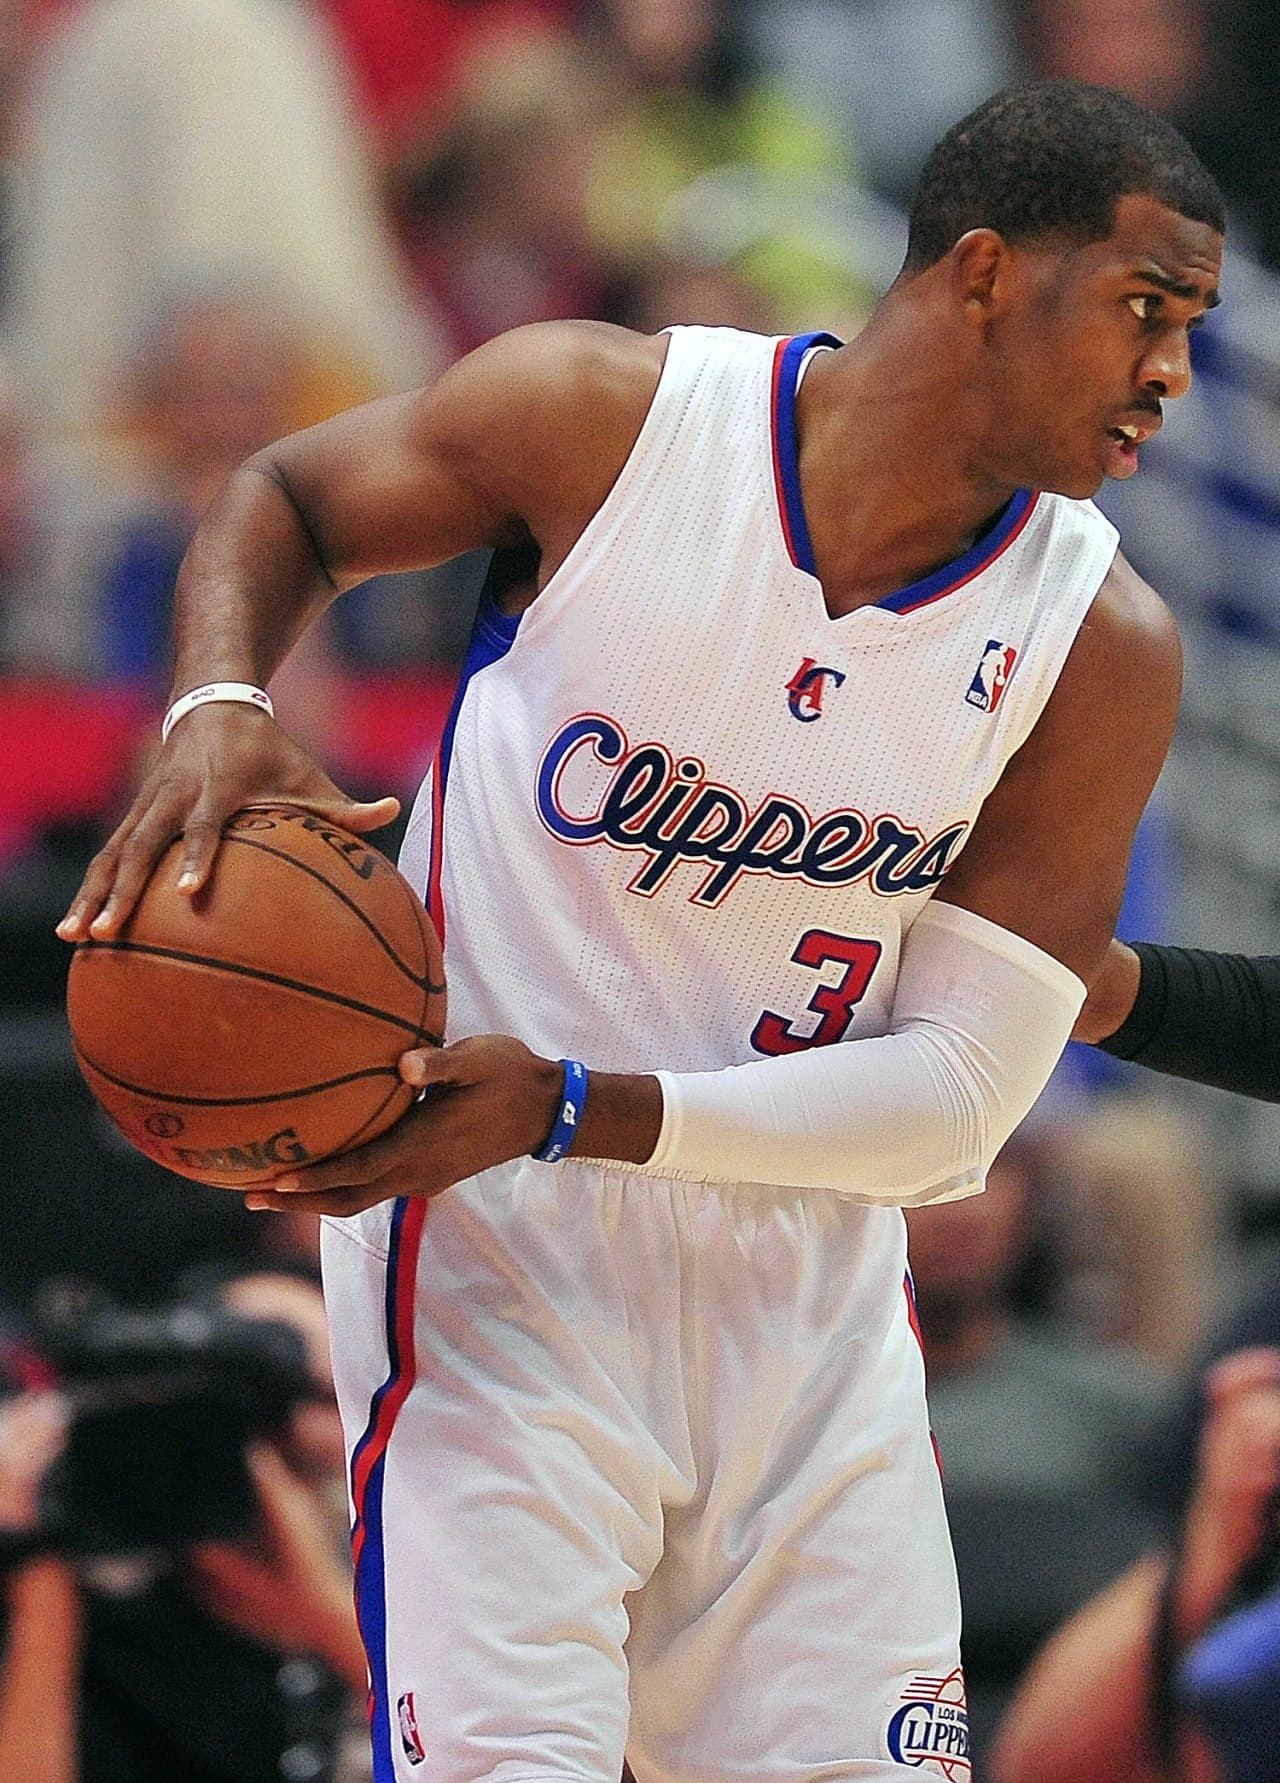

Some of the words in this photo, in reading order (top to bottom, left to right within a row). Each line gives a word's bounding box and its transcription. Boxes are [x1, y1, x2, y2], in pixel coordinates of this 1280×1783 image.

[535, 711, 968, 908] Clippers
[749, 928, 882, 1057] 3
[938, 1707, 956, 1721] LOS
